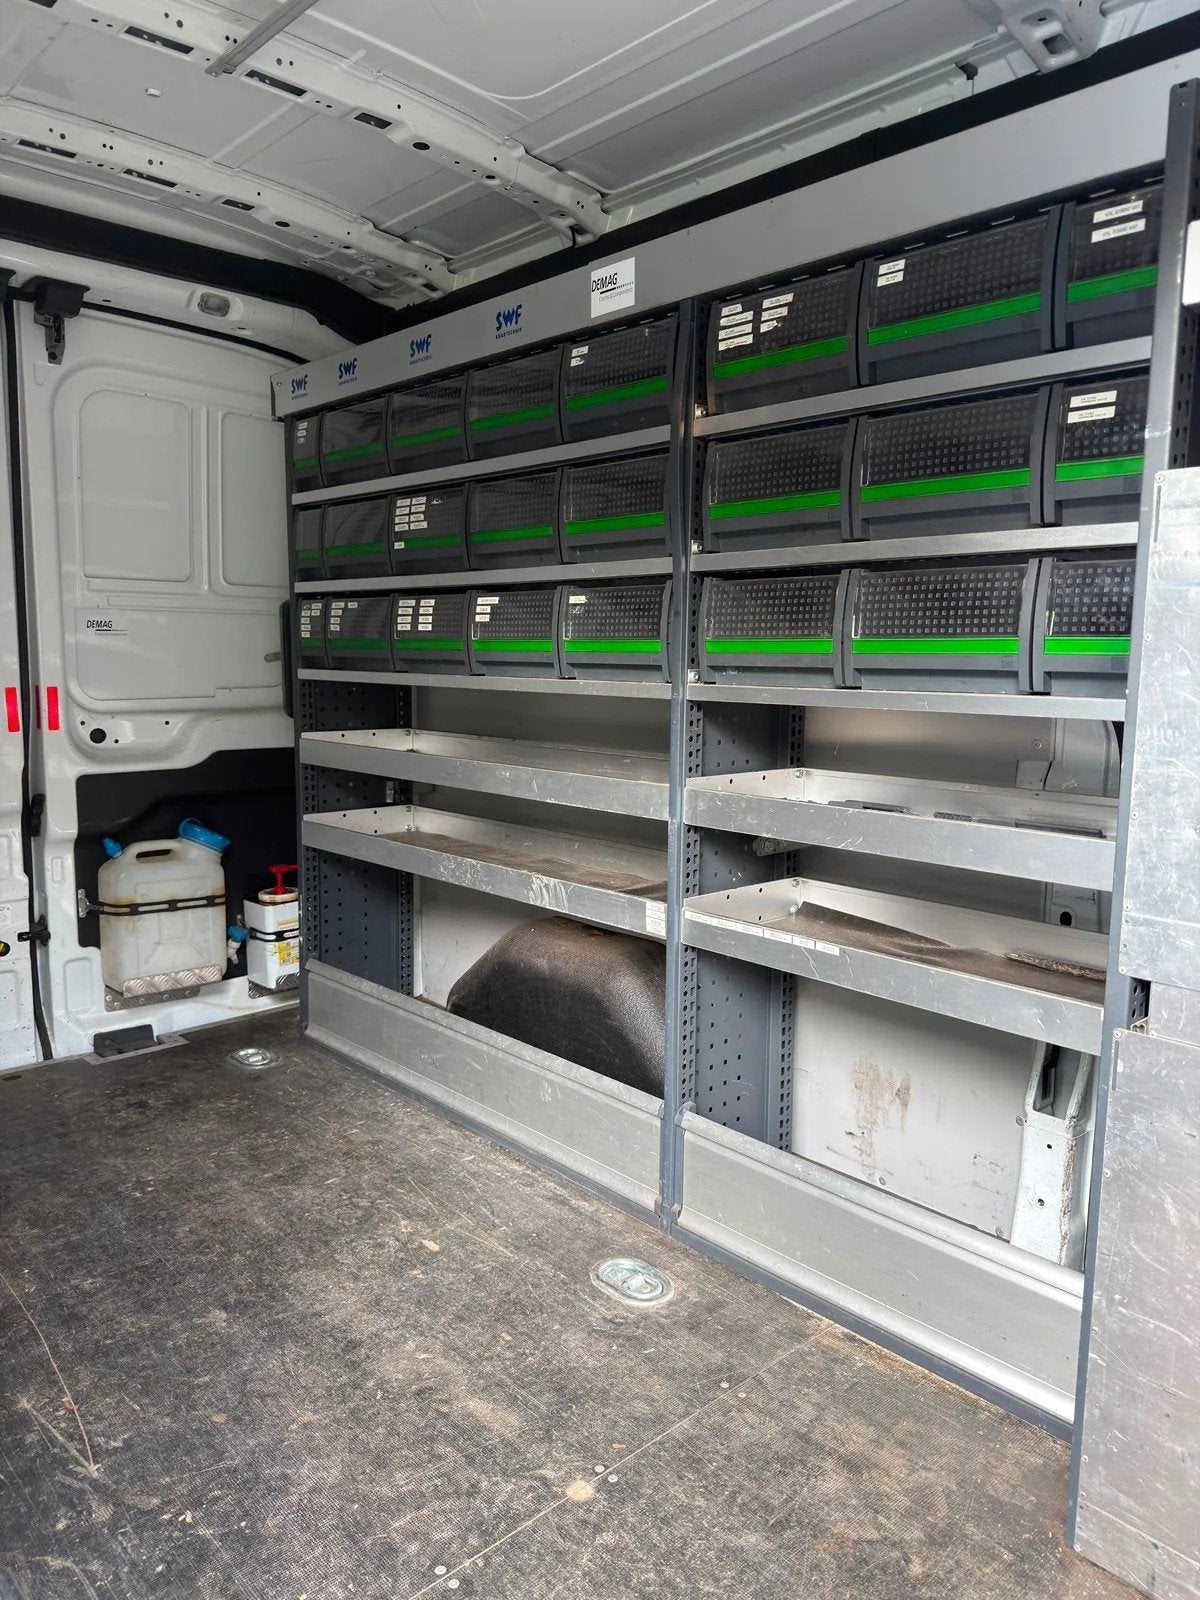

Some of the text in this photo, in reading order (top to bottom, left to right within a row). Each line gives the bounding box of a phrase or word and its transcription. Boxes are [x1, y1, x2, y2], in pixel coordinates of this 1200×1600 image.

[591, 272, 618, 292] DEMAG
[496, 304, 522, 331] SWF
[410, 334, 432, 357] SWF
[338, 357, 357, 379] SWF
[291, 374, 308, 394] SWF
[86, 619, 112, 628] DEMAG
